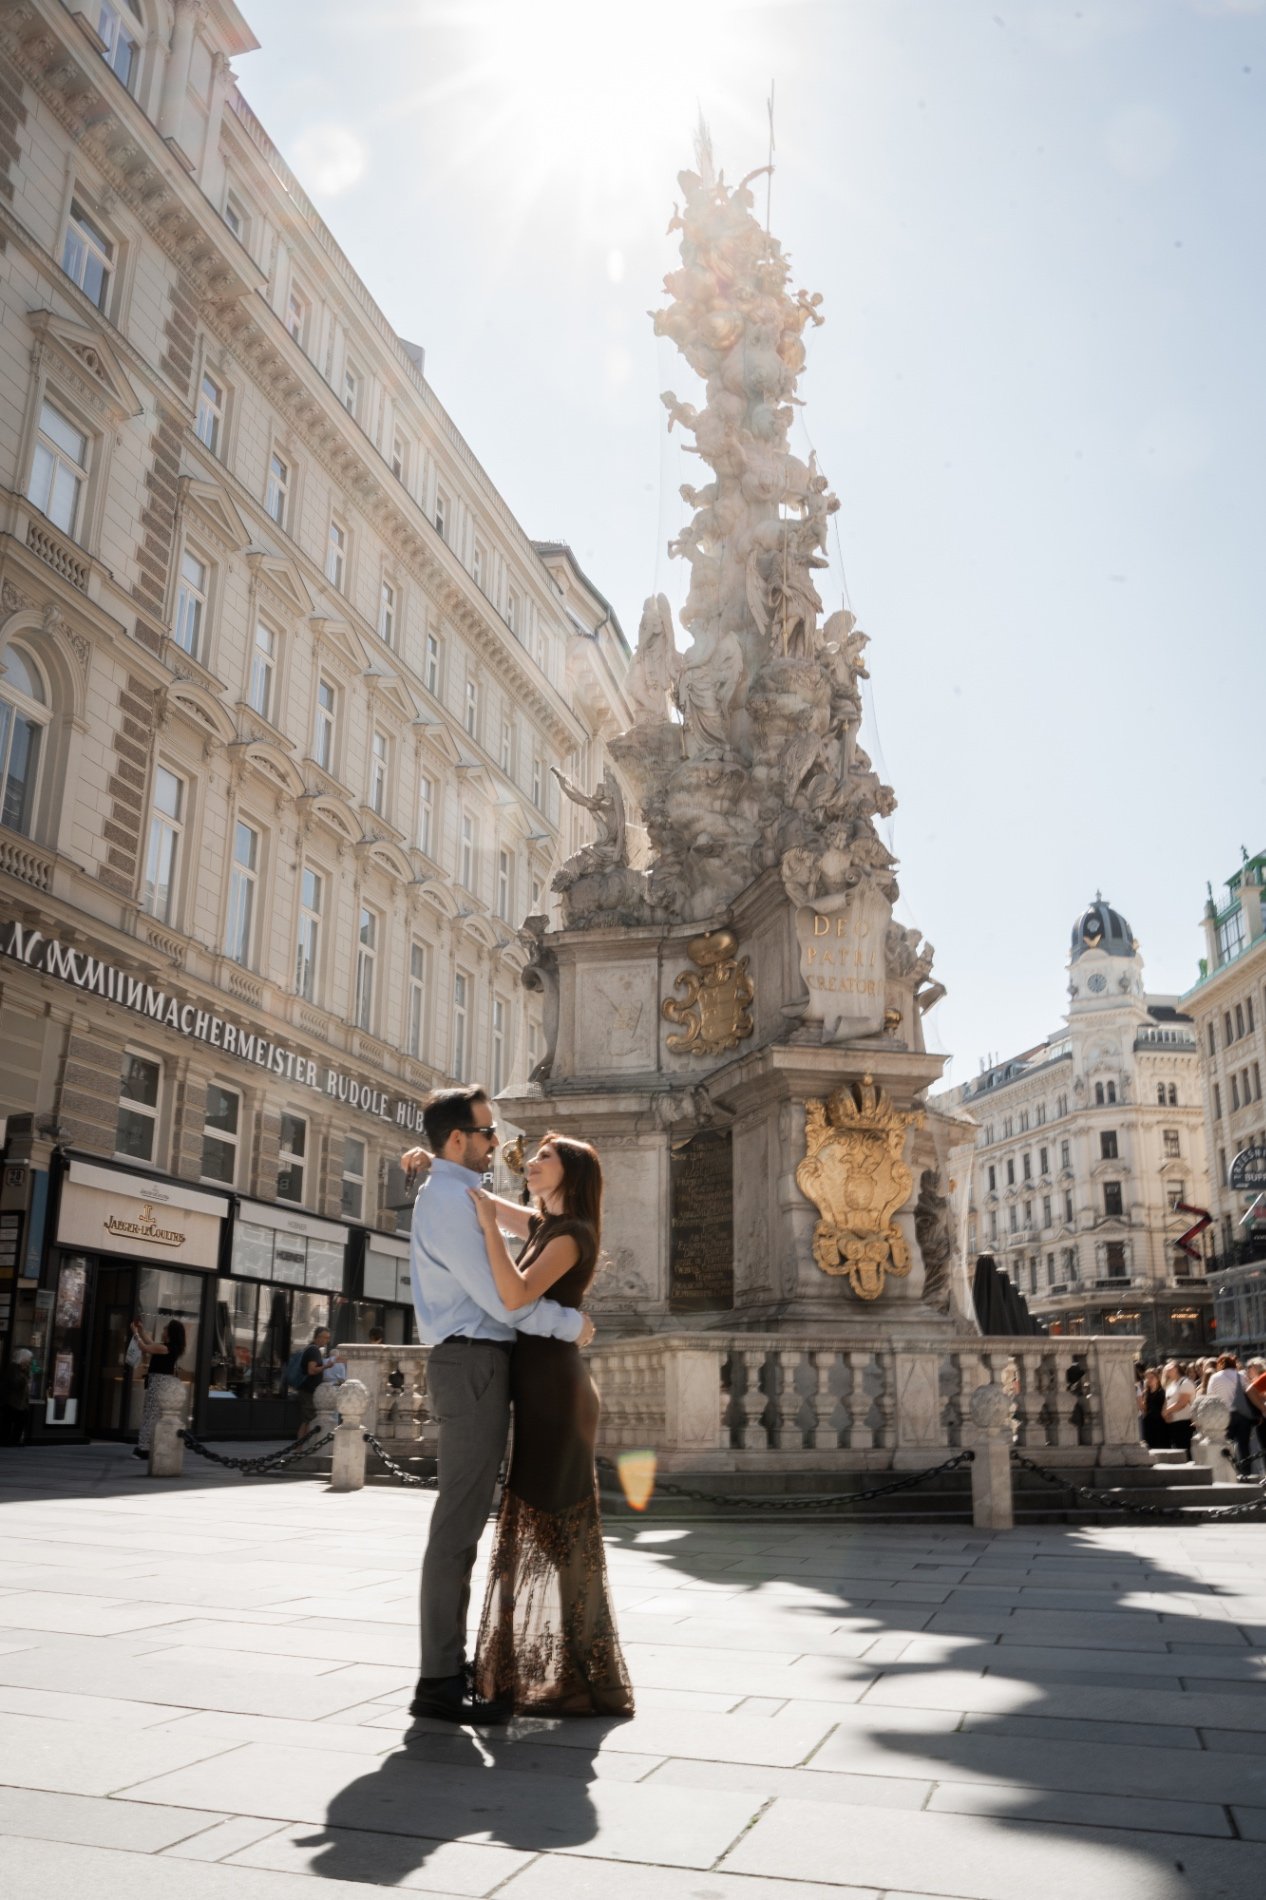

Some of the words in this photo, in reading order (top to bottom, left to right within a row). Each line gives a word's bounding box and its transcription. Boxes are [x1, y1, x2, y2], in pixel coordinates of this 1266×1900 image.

[814, 915, 869, 938] DEO
[807, 947, 876, 966] PATRI
[327, 1070, 388, 1116] RUDOLF
[396, 1101, 427, 1136] HÜB
